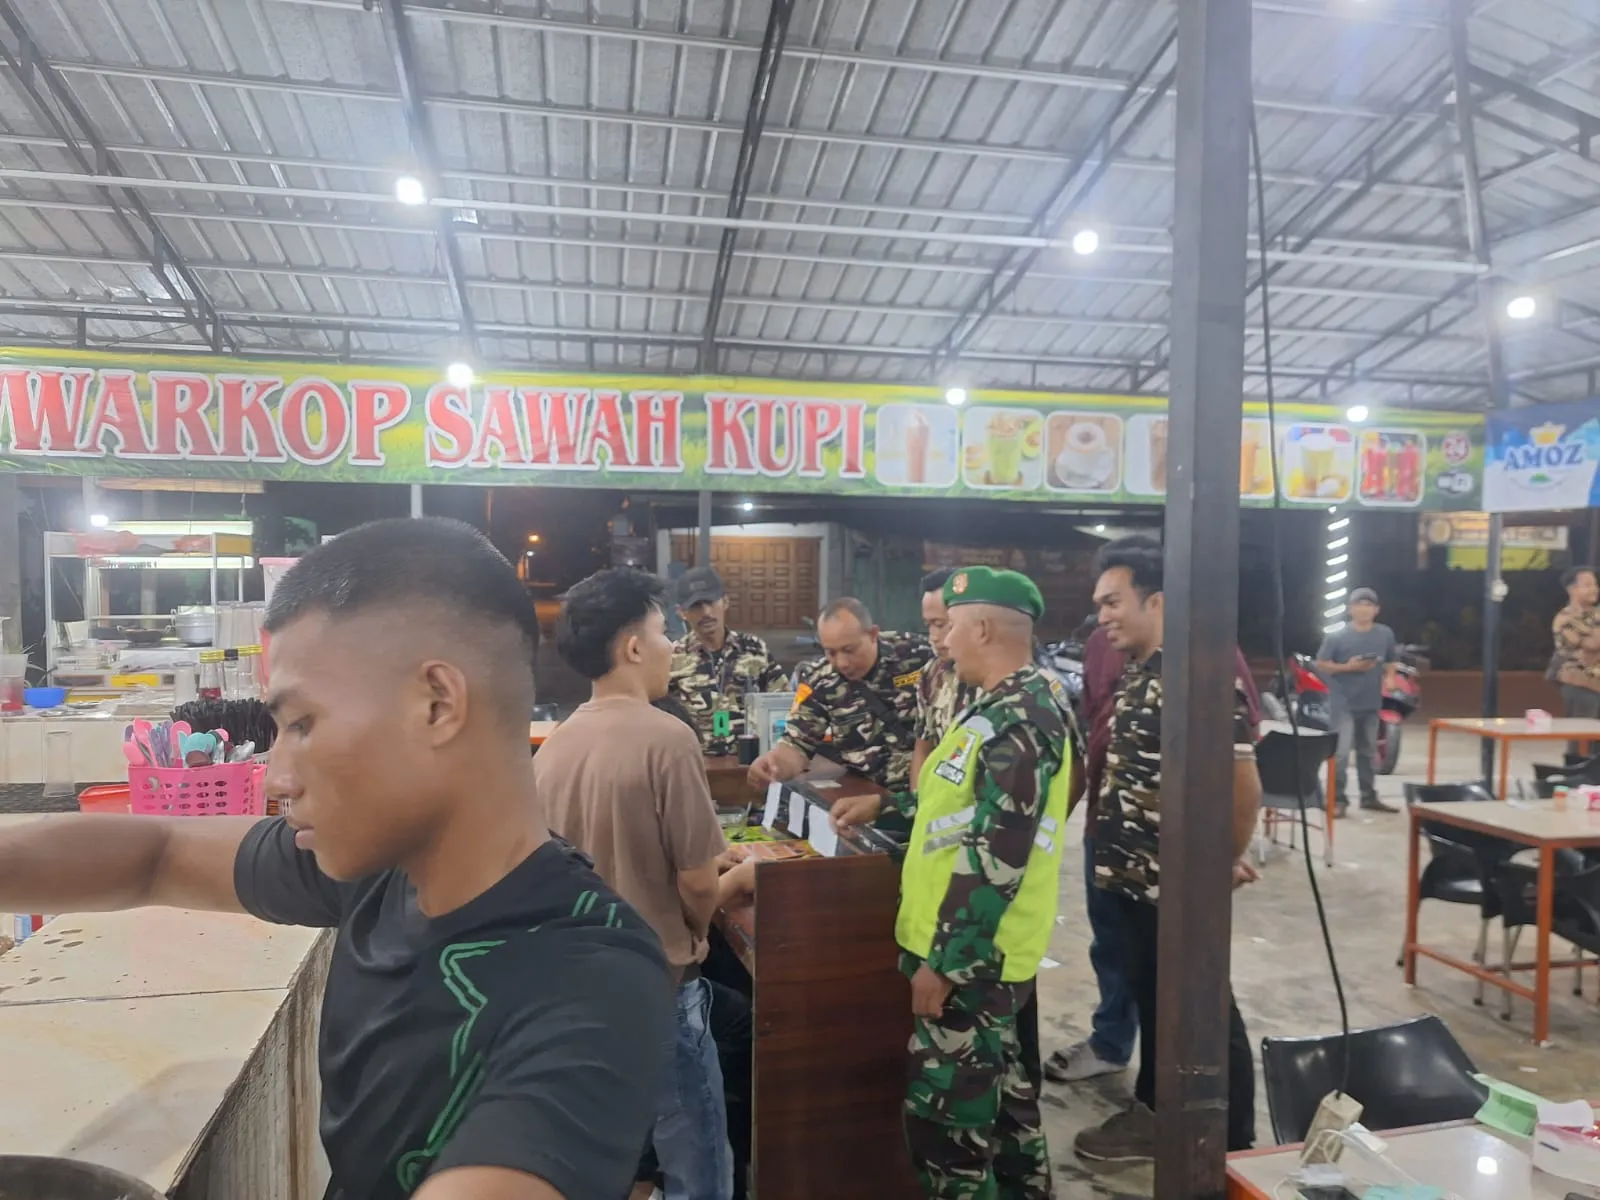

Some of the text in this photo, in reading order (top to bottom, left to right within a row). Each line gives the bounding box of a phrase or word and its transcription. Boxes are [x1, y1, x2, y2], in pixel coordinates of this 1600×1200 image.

[0, 367, 865, 478] WARKOP SAWAH KUPI
[1503, 443, 1584, 471] AMOZ
